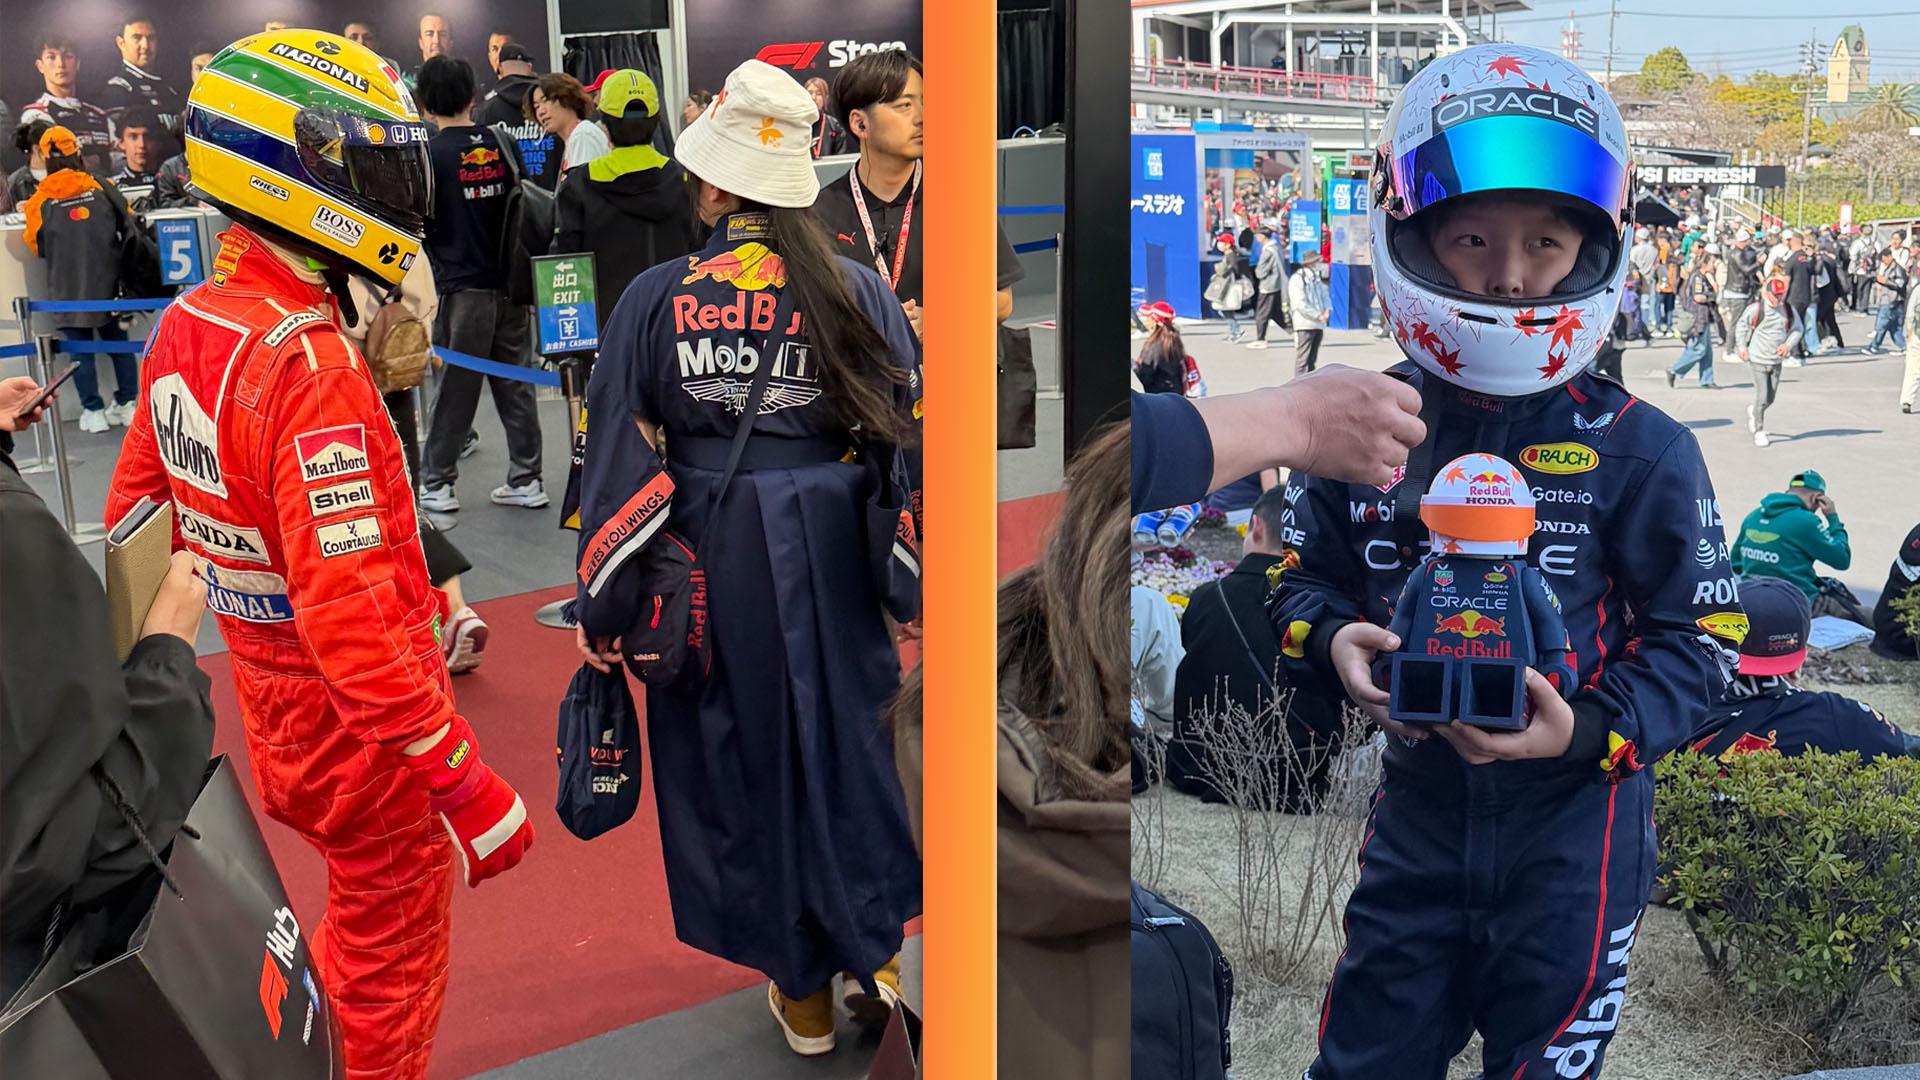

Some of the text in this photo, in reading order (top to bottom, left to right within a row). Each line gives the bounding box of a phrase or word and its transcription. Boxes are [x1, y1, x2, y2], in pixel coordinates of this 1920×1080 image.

[273, 44, 367, 91] NACIONAL
[1436, 91, 1596, 134] ORACLE
[1667, 166, 1756, 183] REFRESH
[317, 206, 364, 238] BOSS
[168, 240, 192, 280] 5
[552, 273, 577, 288] 出口
[553, 290, 580, 305] EXIT
[673, 291, 746, 335] Red
[305, 451, 366, 478] Marlboro
[1539, 449, 1590, 466] RAUCH
[315, 485, 371, 509] Shell
[1465, 497, 1517, 505] HONDA
[1470, 485, 1511, 497] Red Bull
[1530, 486, 1593, 505] Gate.io
[602, 527, 628, 550] YOU
[626, 490, 665, 529] WINGS
[1350, 499, 1396, 523] Mobi
[1696, 498, 1724, 528] VIS
[180, 513, 260, 554] ONDA
[1535, 520, 1591, 535] ONDA
[323, 534, 381, 555] COURTAULDS
[1430, 595, 1508, 610] ORACLE
[1427, 638, 1511, 659] Red Bull
